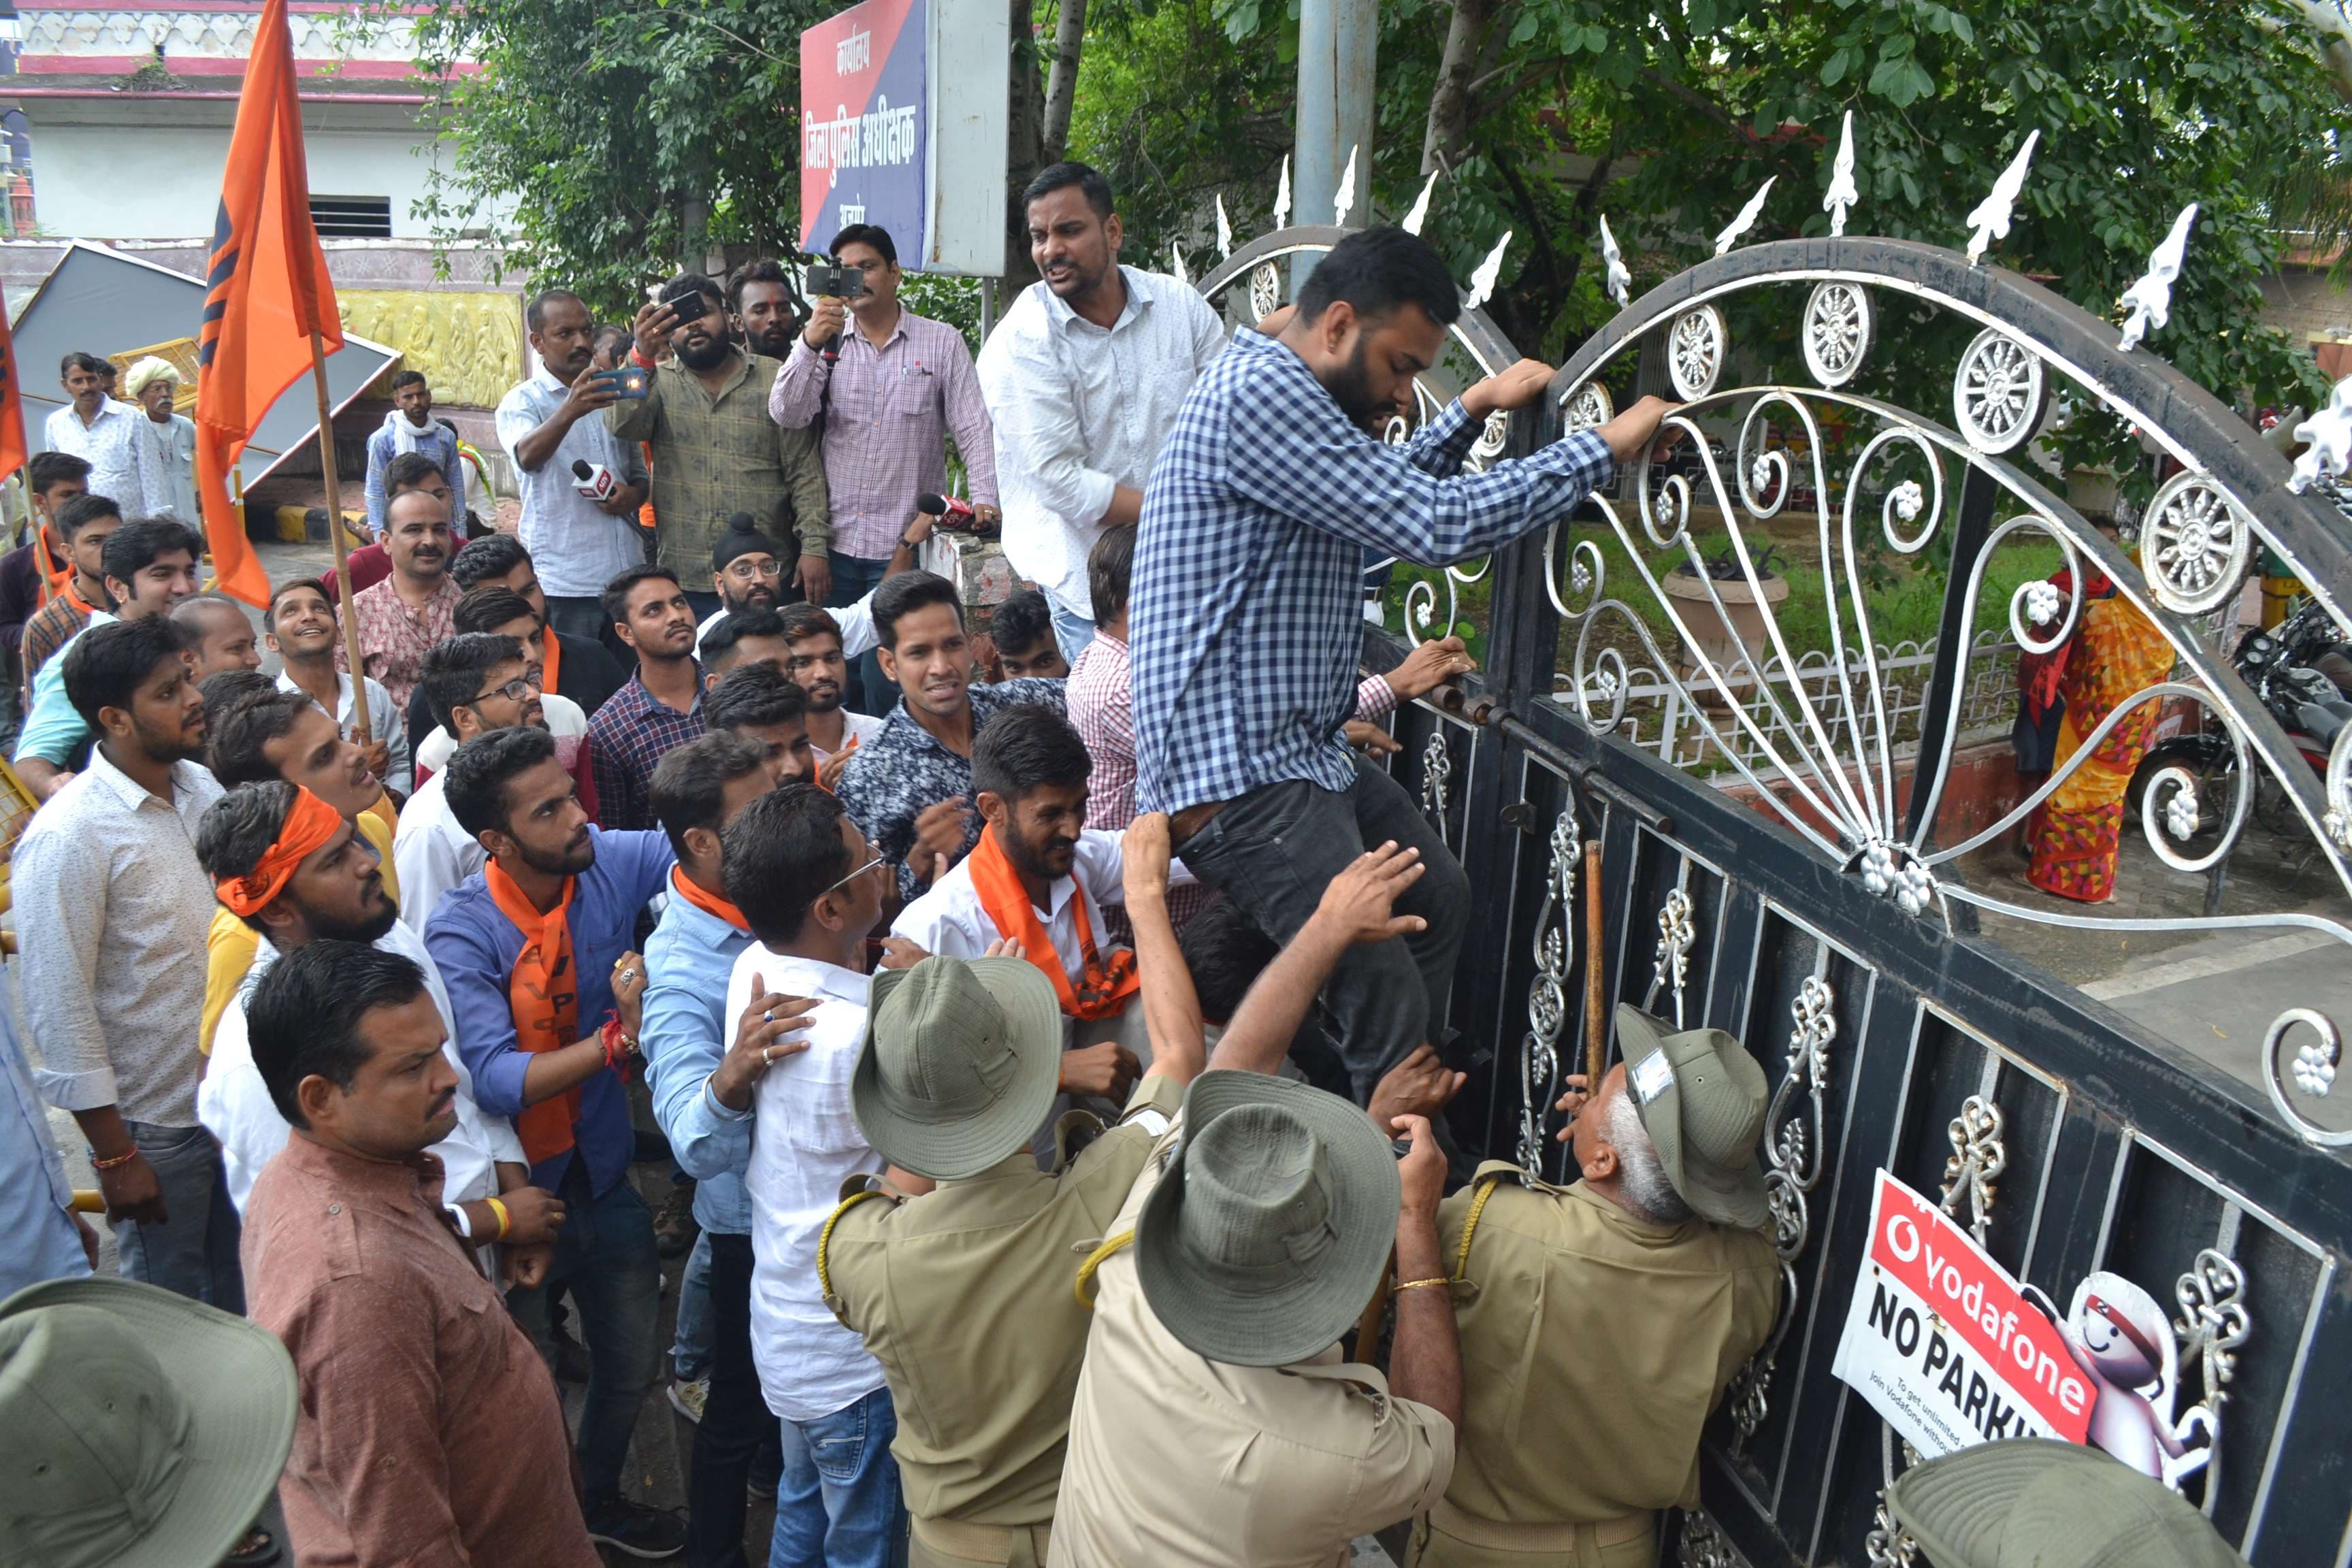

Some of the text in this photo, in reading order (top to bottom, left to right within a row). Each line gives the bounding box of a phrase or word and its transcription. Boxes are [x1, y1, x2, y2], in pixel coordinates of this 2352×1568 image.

[837, 22, 870, 76] कार्यालय
[805, 95, 916, 189] जिला पुलिस अधीक्षक
[1868, 1282, 2037, 1441] NO PARK
[1924, 1243, 2085, 1416] vodafone
[1869, 1370, 1885, 1390] join
[1886, 1384, 1923, 1426] Vodafone
[1897, 1377, 1960, 1446] To get unlimited
